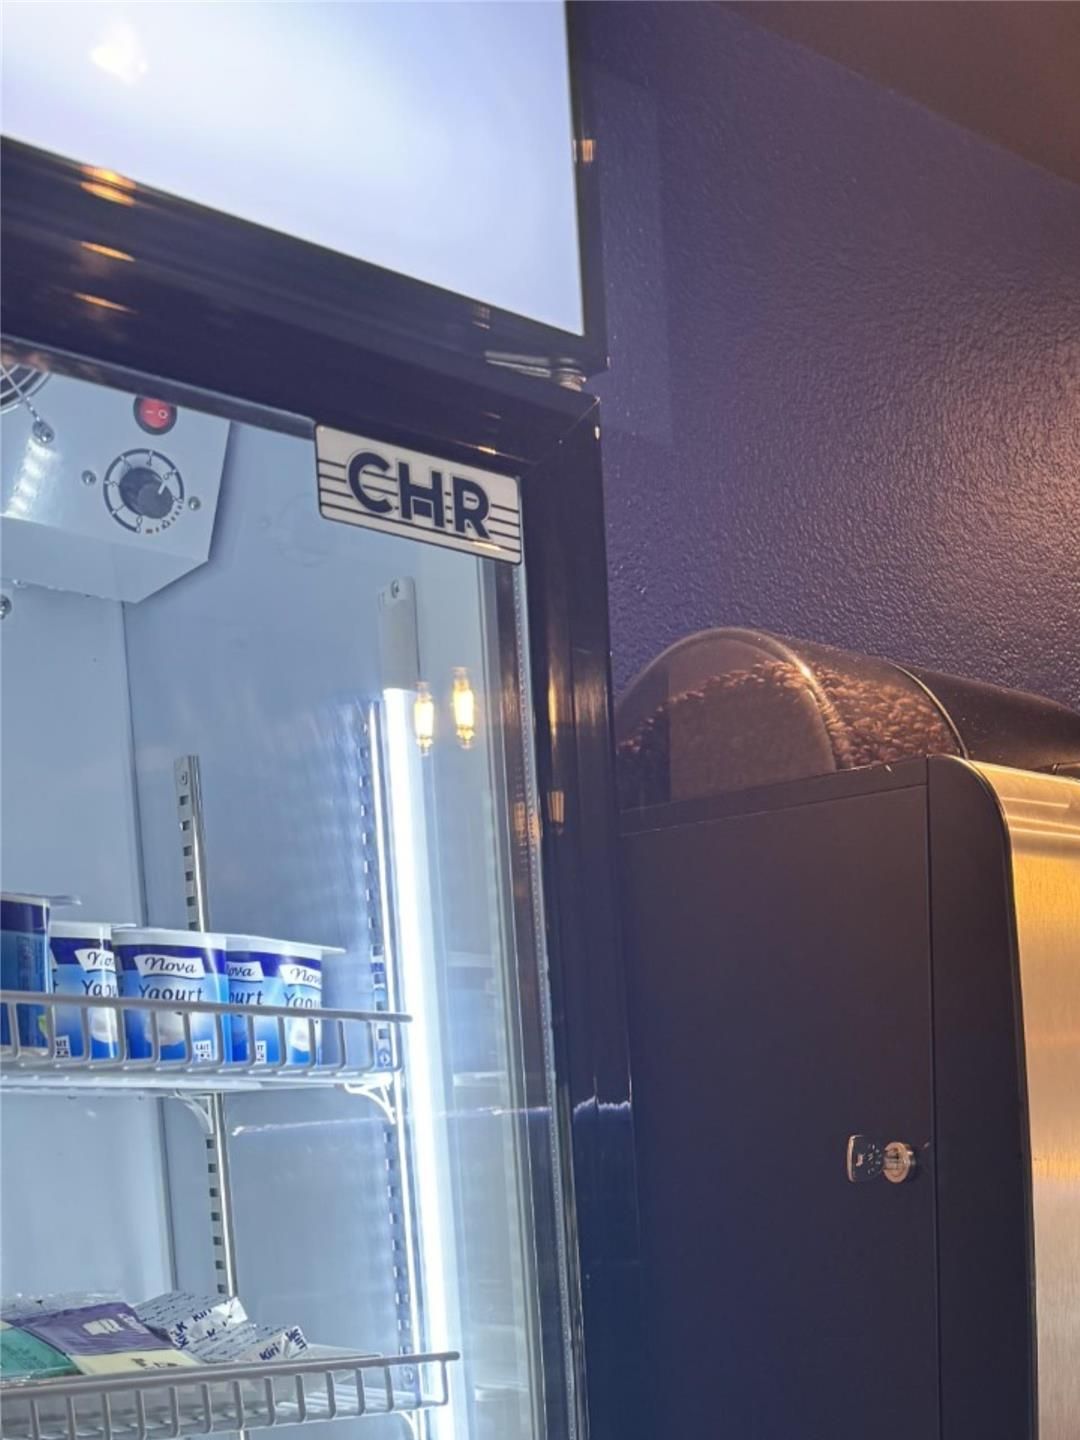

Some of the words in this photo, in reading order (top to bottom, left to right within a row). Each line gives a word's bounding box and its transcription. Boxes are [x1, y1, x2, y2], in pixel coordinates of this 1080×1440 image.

[348, 452, 491, 539] CHR
[144, 956, 198, 973] Nova
[139, 984, 203, 1001] Yaourt
[259, 1343, 281, 1360] Kiri
